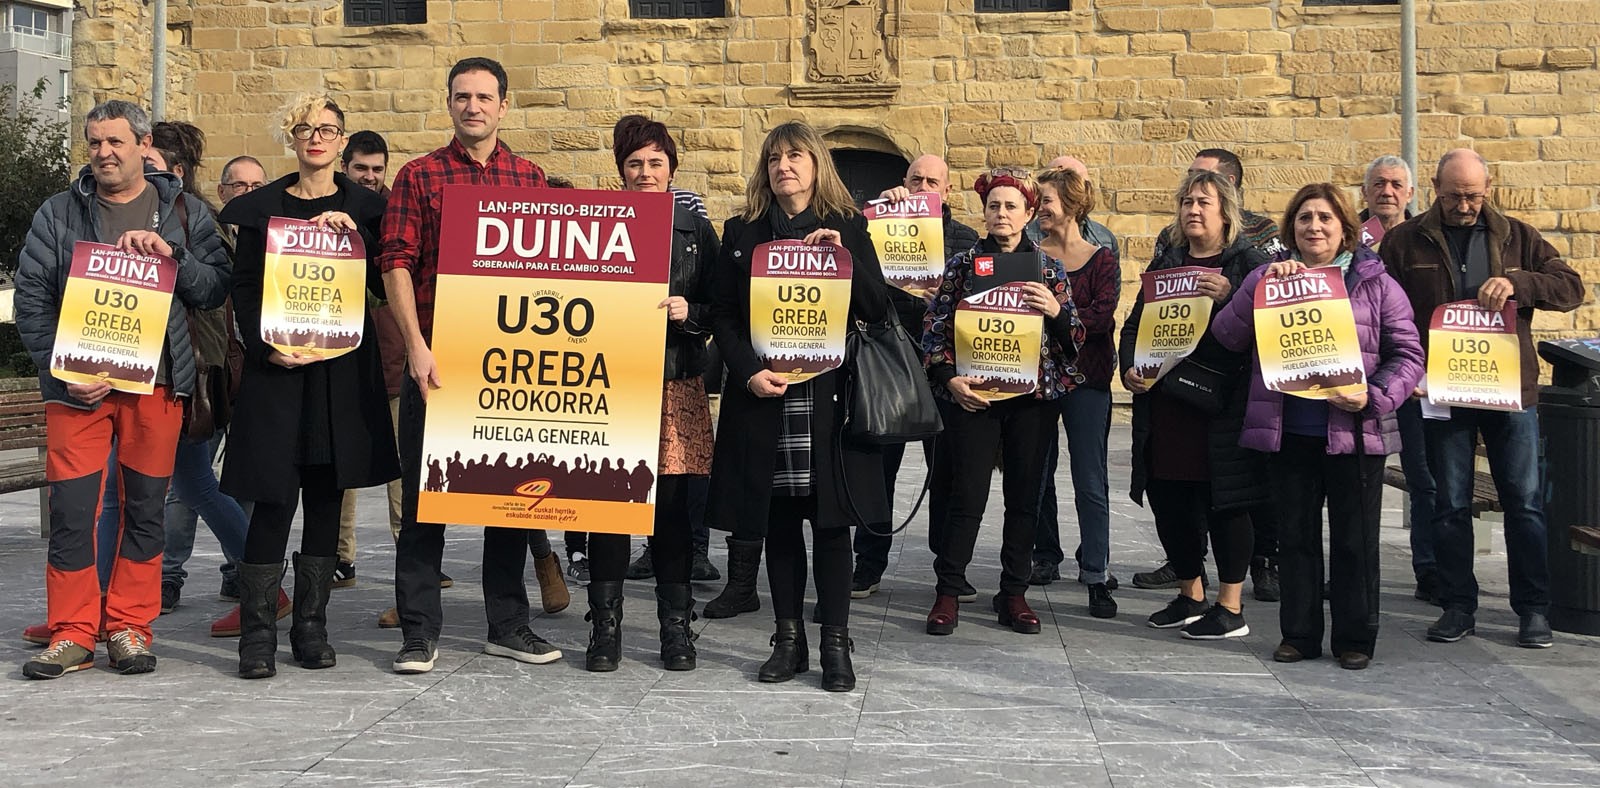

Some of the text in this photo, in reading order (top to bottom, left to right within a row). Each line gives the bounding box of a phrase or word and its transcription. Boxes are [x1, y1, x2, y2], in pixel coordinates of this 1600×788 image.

[478, 201, 636, 218] LAN-PENTSIO-BIZITZA
[876, 200, 929, 215] DUINA
[476, 216, 636, 262] DUINA
[887, 224, 919, 237] U30
[283, 231, 352, 252] DUINA
[885, 241, 926, 253] GREBA
[88, 255, 159, 282] DUINA
[472, 259, 634, 274] SOBERANÍA PARA EL CAMBIO SOCIAL
[768, 252, 837, 270] DUINA
[292, 263, 335, 282] U30
[286, 284, 342, 303] GREBA
[778, 286, 821, 303] U30
[1266, 278, 1332, 300] DUINA
[94, 288, 138, 311] U30
[284, 301, 342, 314] OROKORA
[497, 295, 594, 337] U30
[773, 308, 827, 325] GREBA
[1159, 304, 1190, 319] U30
[1280, 308, 1322, 328] U30
[1443, 309, 1504, 326] DUINA
[85, 310, 142, 334] GREBA
[772, 325, 826, 336] OROKORRA
[978, 318, 1014, 333] U30
[1154, 323, 1194, 337] GREBA
[82, 327, 140, 345] OROKORRA
[1280, 328, 1335, 348] GREBA
[78, 342, 139, 358] HUELGA GENERAL
[973, 337, 1021, 353] GREBA
[1282, 344, 1338, 358] OROKORRA
[1453, 339, 1490, 354] U30
[972, 351, 1021, 363] OROKORRA
[1282, 360, 1309, 371] HUELGA
[1448, 358, 1499, 373] GREBA
[482, 348, 610, 388] GREBA
[995, 365, 1021, 374] GENERAL
[1448, 373, 1499, 383] OROKORRA
[479, 388, 608, 415] OROKORRA
[473, 425, 609, 446] HUELGA GENERAL
